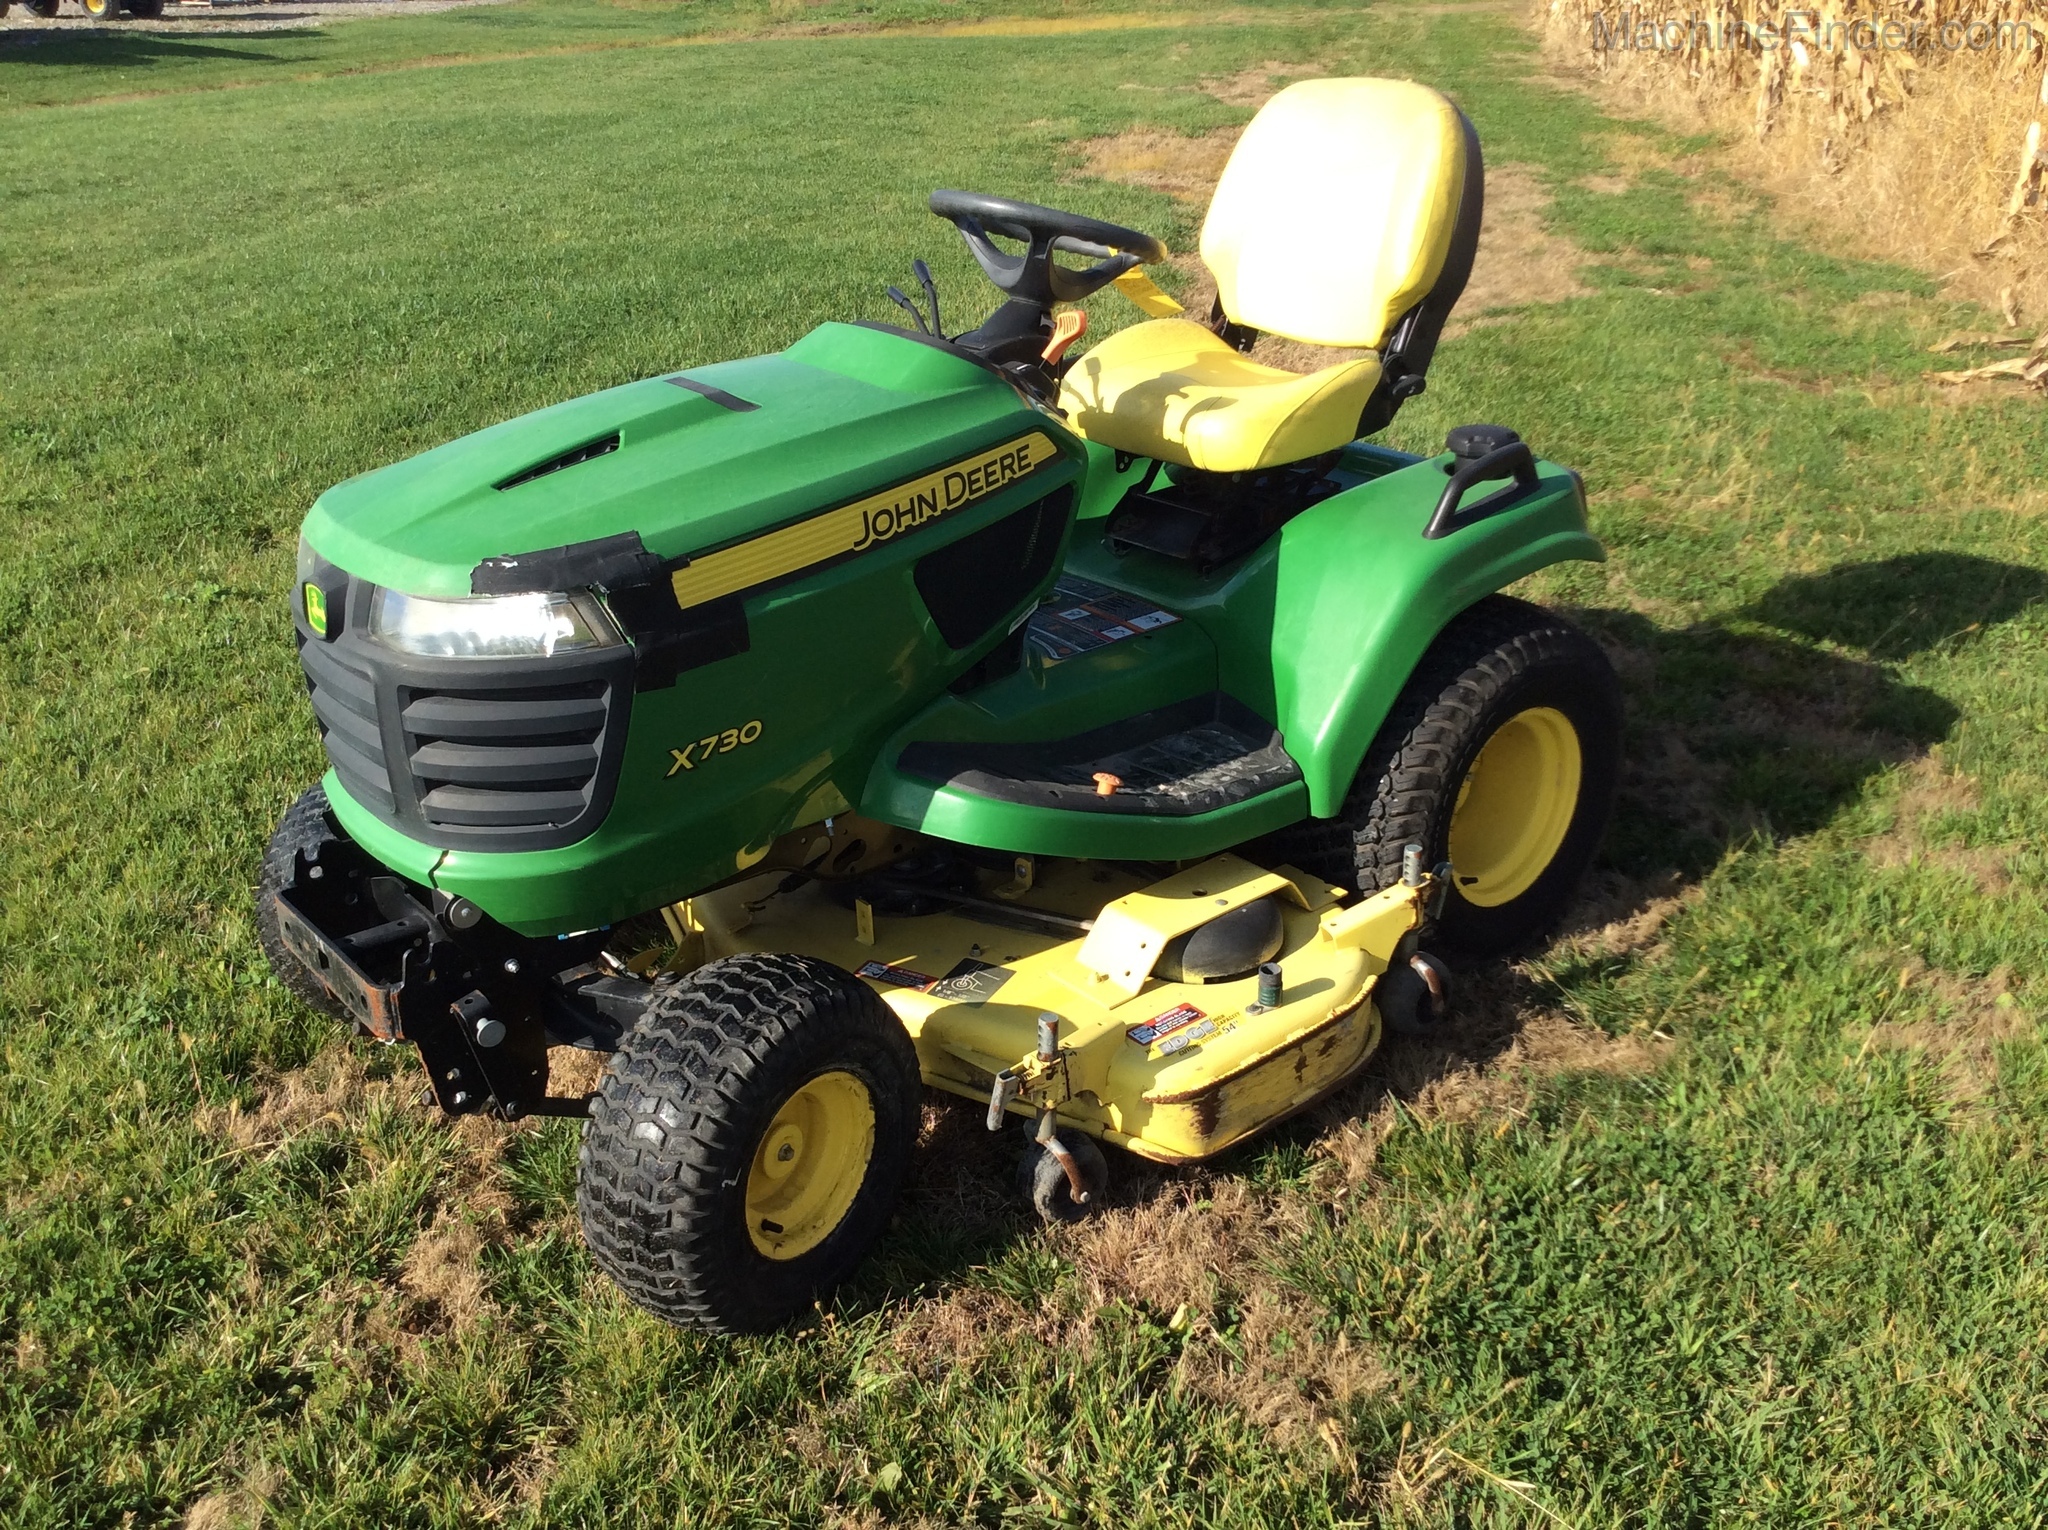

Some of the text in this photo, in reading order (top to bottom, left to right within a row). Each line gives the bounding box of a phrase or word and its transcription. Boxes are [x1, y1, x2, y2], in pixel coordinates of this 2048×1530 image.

[853, 443, 1033, 549] JOHN DEERE
[665, 719, 763, 778] X730
[1158, 1018, 1219, 1056] EDGE
